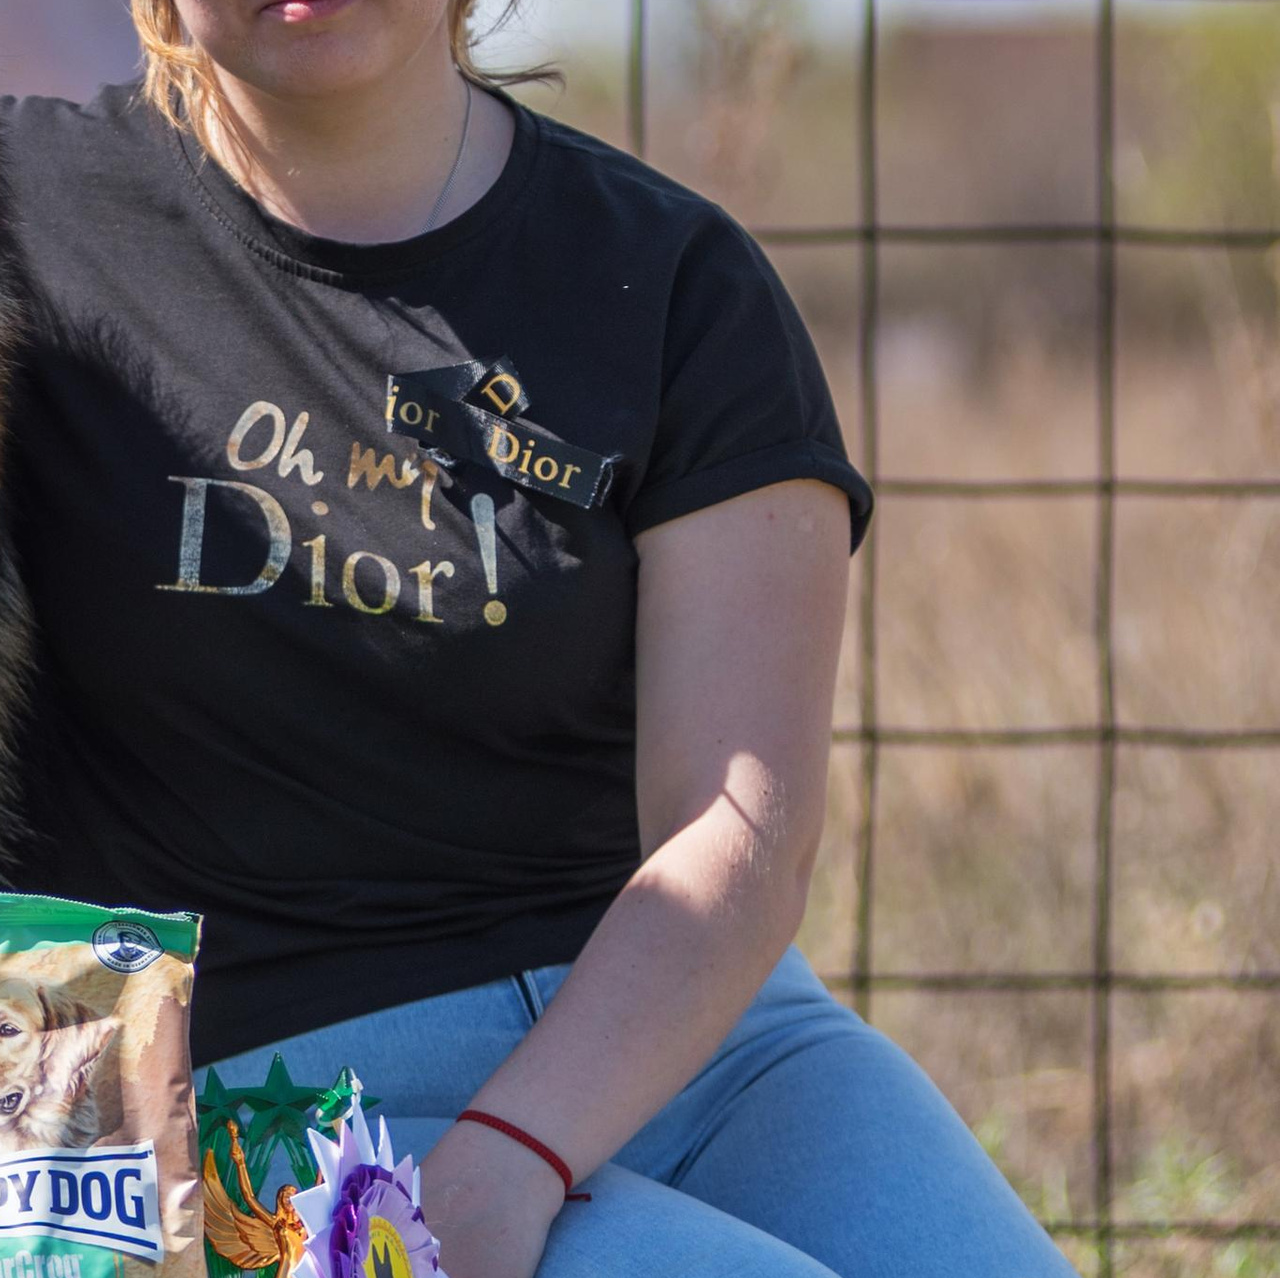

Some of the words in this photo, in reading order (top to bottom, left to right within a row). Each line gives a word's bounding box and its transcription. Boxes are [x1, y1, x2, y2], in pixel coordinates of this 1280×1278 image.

[481, 372, 523, 416] D
[226, 400, 324, 486] Oh
[487, 423, 582, 489] Dior
[154, 475, 508, 627] Dior!
[47, 1166, 148, 1231] DOG
